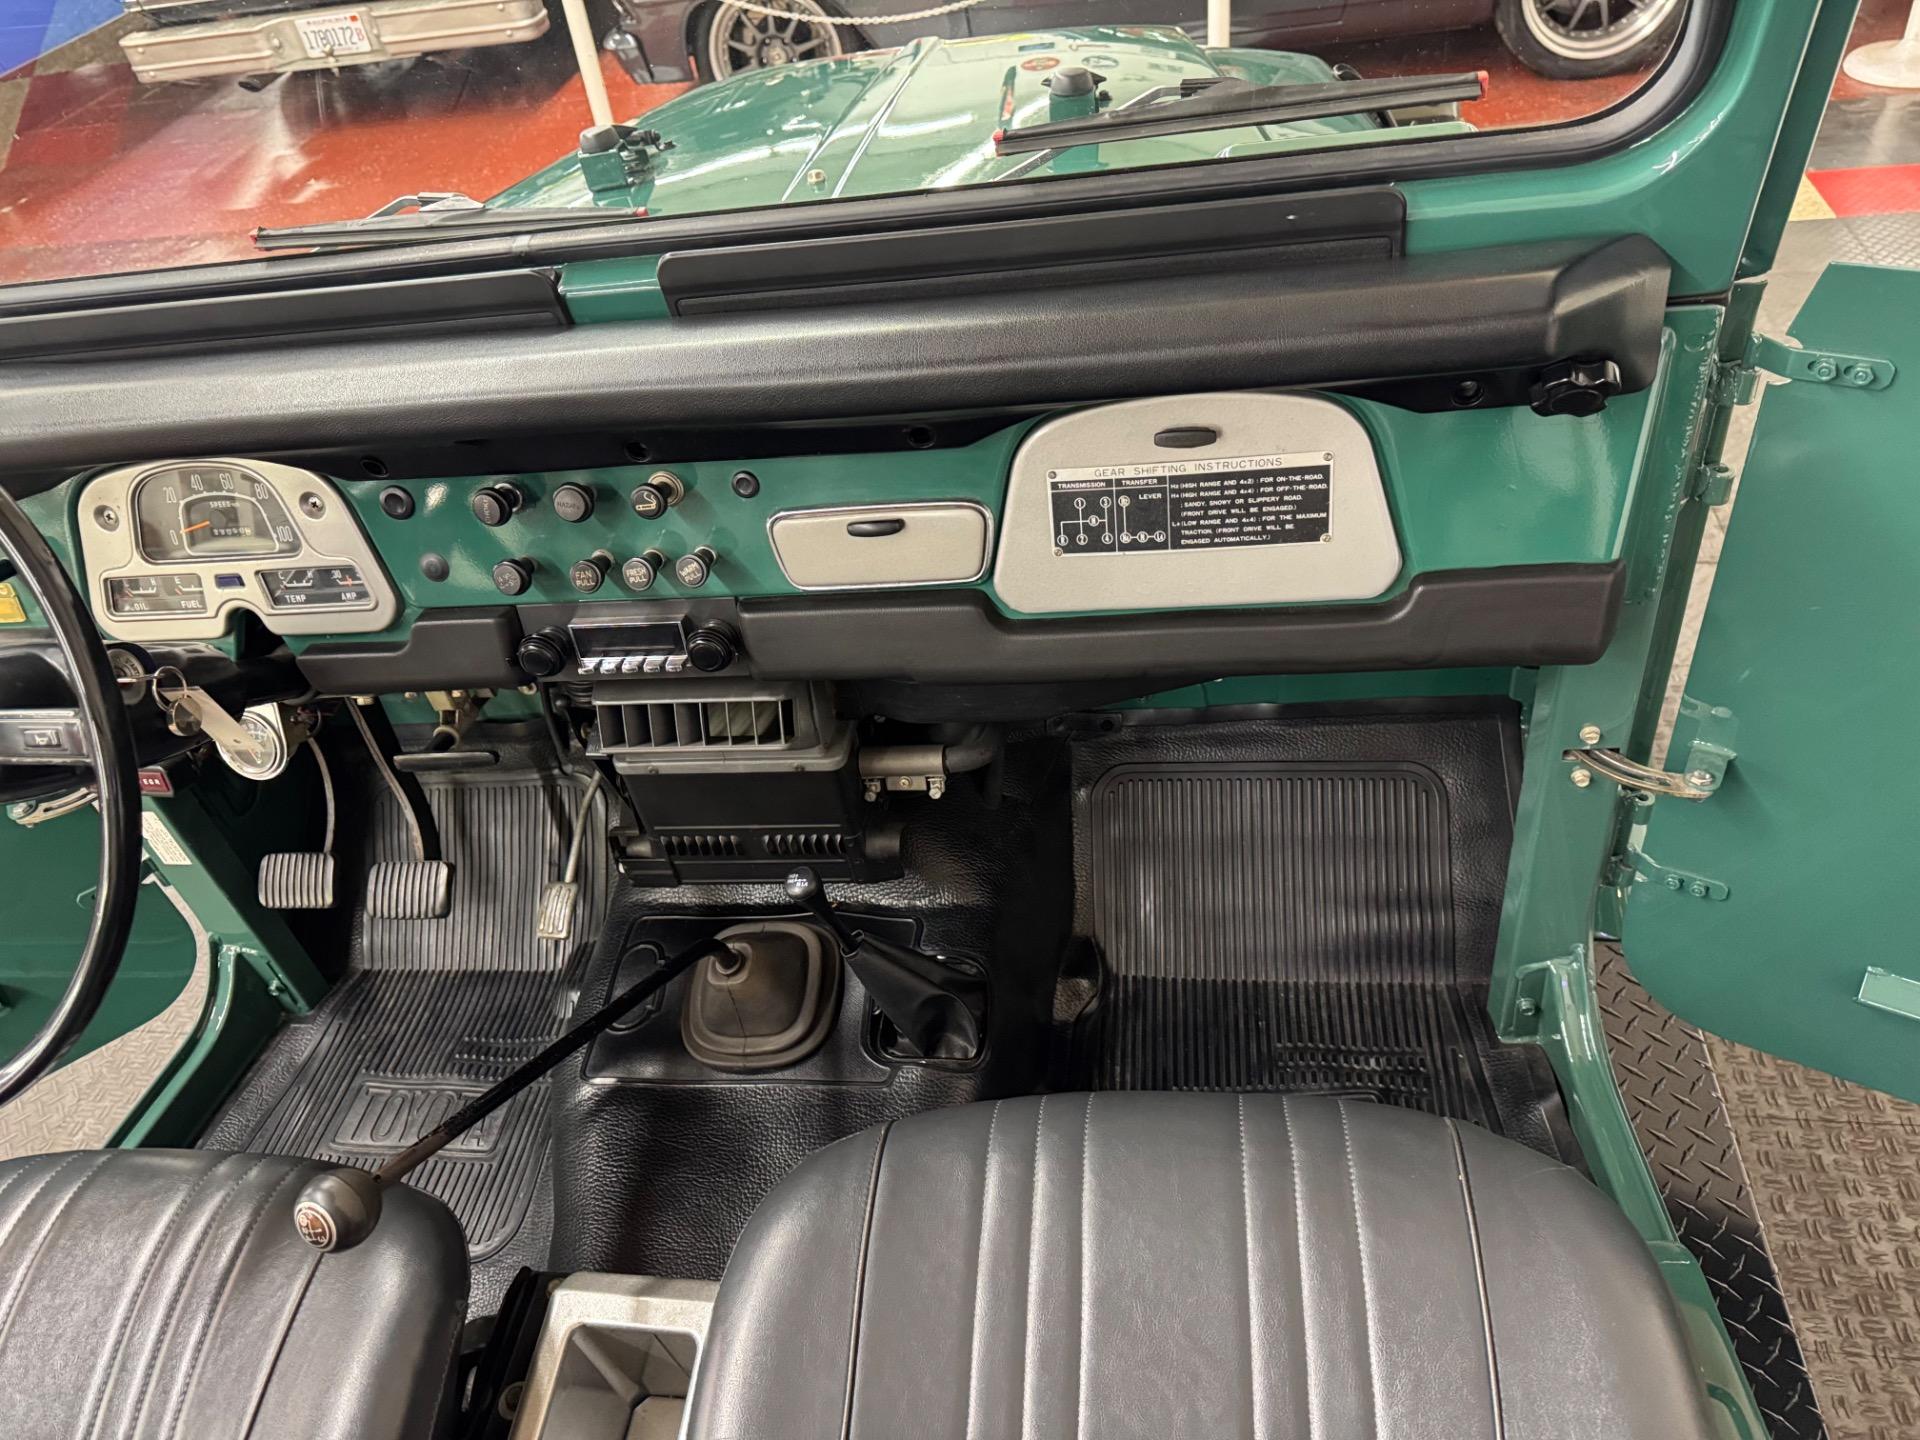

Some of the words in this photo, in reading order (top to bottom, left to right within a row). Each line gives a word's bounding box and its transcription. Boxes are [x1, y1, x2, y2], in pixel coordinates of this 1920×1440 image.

[1095, 468, 1126, 477] GEAR
[1134, 464, 1186, 476] SHIFTING
[1194, 458, 1283, 471] INSTRUCTIONS
[190, 474, 204, 491] 40
[219, 473, 234, 490] 60
[163, 486, 176, 503] 20
[254, 483, 269, 500] 80
[170, 530, 178, 546] 0
[276, 526, 293, 542] 100
[576, 570, 592, 579] FAN
[284, 594, 306, 603] TEMP
[341, 592, 357, 600] AMP
[181, 600, 202, 608] FUEL
